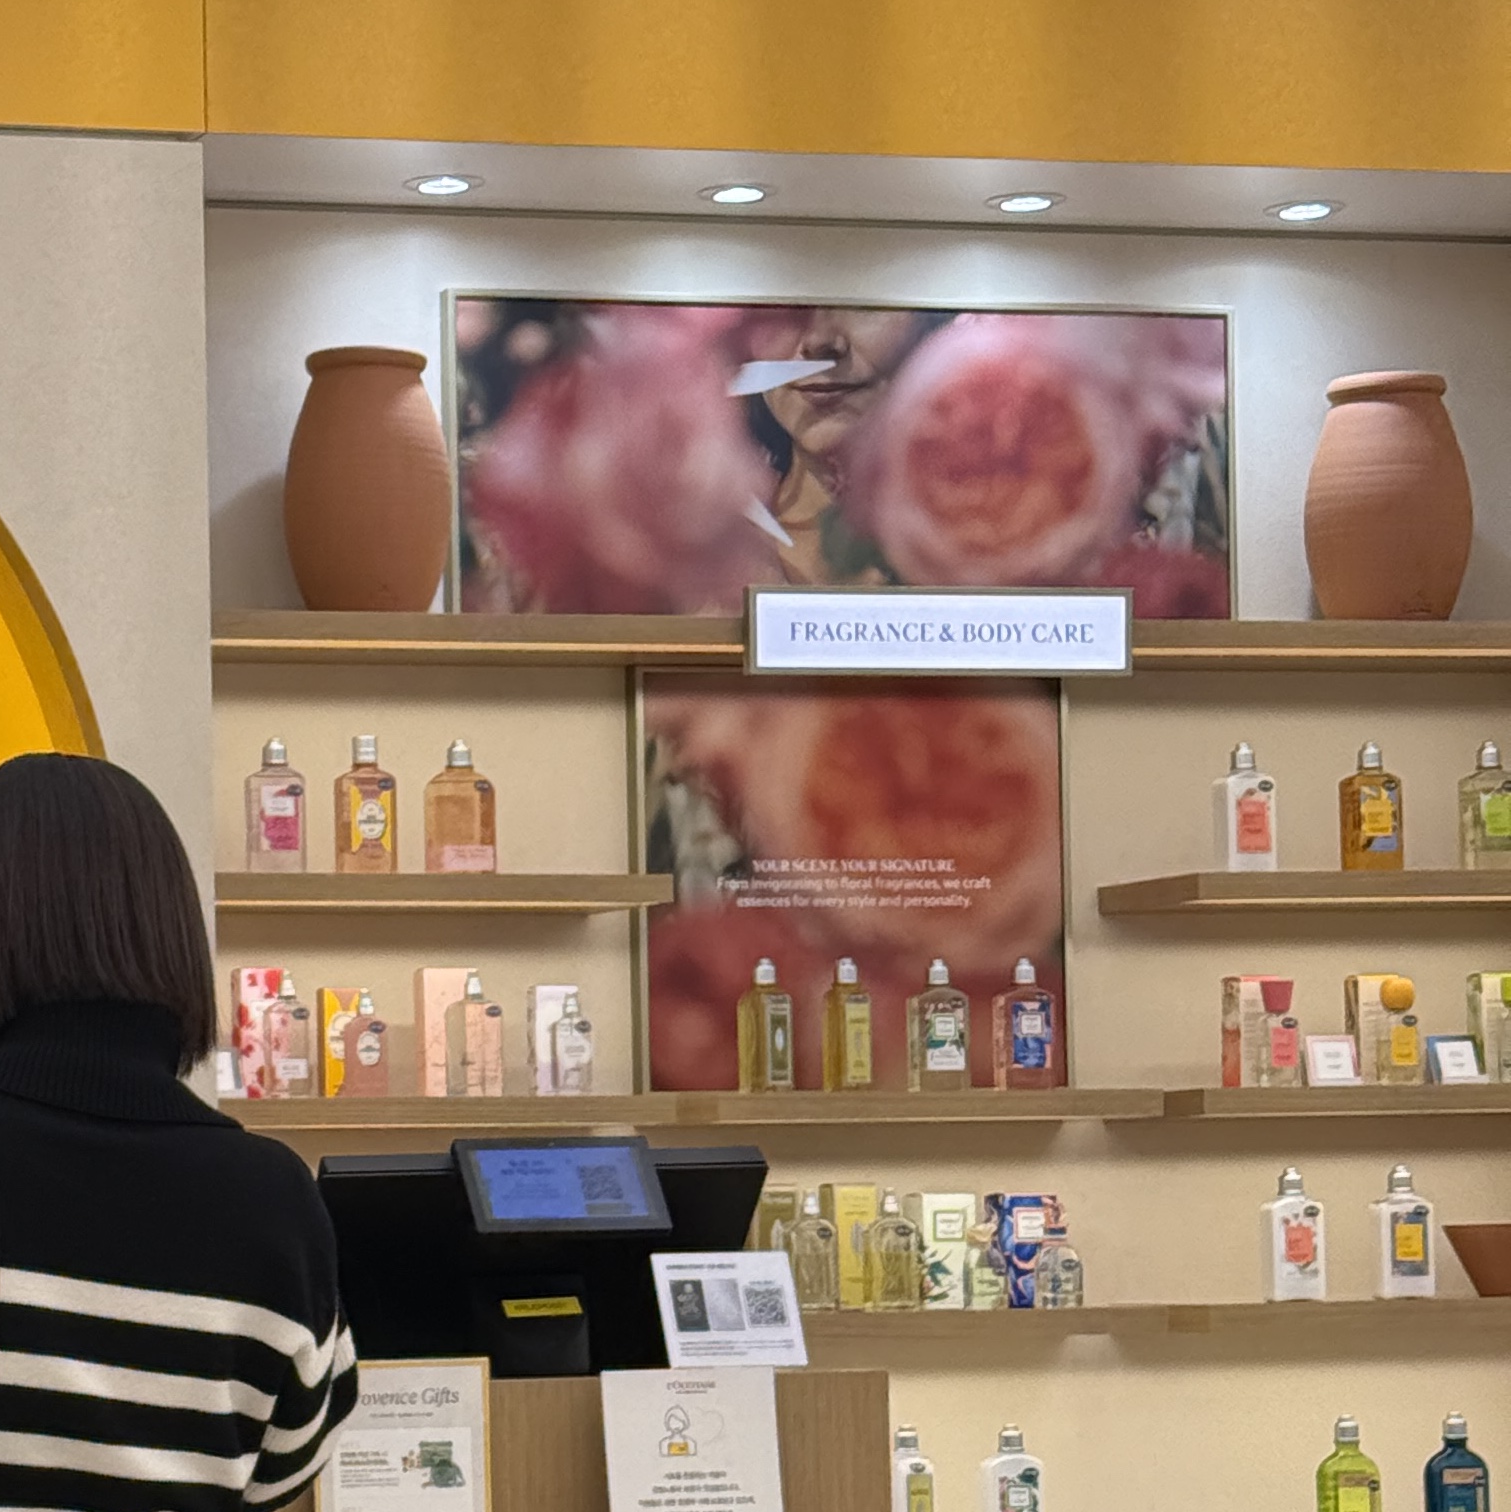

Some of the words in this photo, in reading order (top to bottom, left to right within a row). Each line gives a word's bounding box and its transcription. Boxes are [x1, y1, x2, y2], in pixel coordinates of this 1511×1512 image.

[789, 621, 935, 643] FRAGRANCE
[938, 622, 956, 643] &
[962, 622, 1027, 643] BODY
[1031, 622, 1095, 644] CARE
[752, 859, 790, 872] YOUR
[840, 858, 877, 872] YOUR
[716, 876, 749, 890] From
[824, 877, 839, 890] to
[840, 876, 873, 890] floral
[943, 879, 961, 889] we
[962, 875, 991, 890] craft
[736, 896, 790, 908] essences
[793, 894, 809, 907] for
[812, 897, 846, 909] every
[848, 894, 877, 908] style
[879, 894, 901, 907] and
[360, 1390, 418, 1406] ovence
[421, 1387, 460, 1407] Gifts
